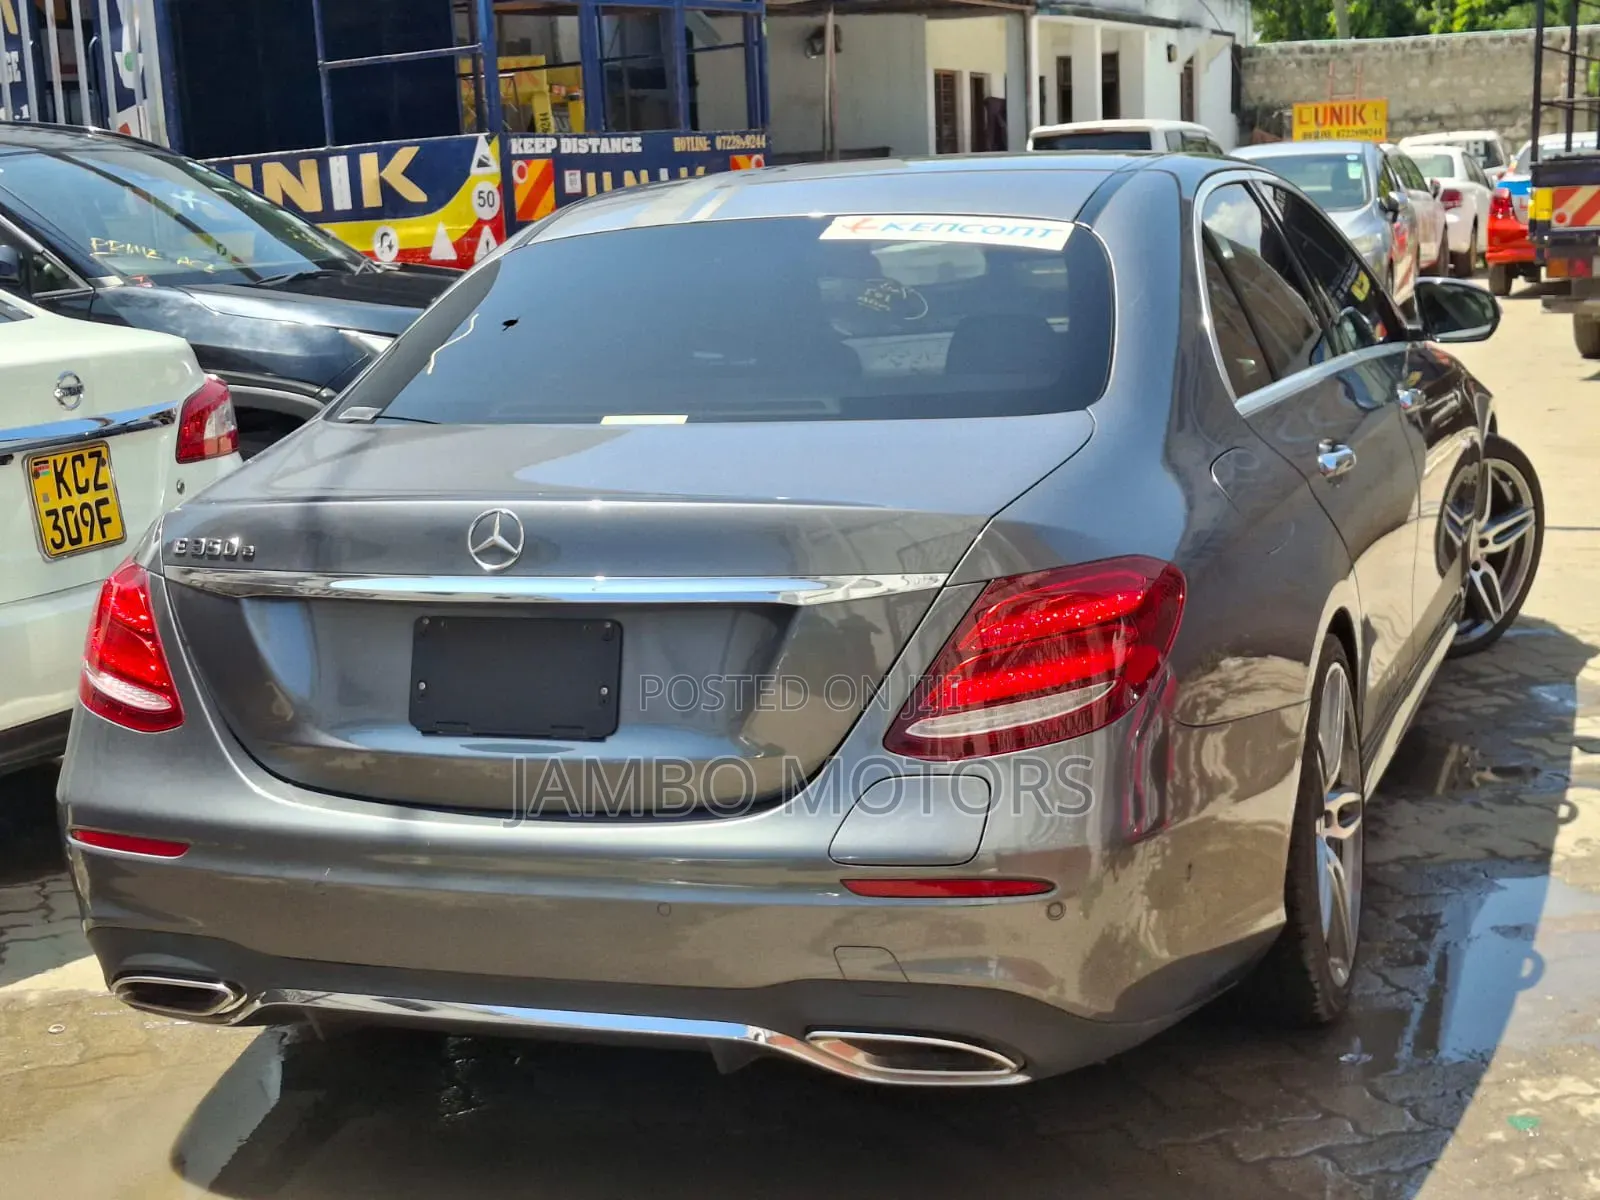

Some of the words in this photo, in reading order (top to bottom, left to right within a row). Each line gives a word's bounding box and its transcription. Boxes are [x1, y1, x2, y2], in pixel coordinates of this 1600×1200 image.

[1314, 104, 1367, 127] UNIK
[511, 137, 557, 154] KEEP
[560, 136, 642, 153] DISTANCE
[477, 191, 495, 208] 50
[52, 450, 108, 500] KCZ
[45, 497, 113, 550] 309F
